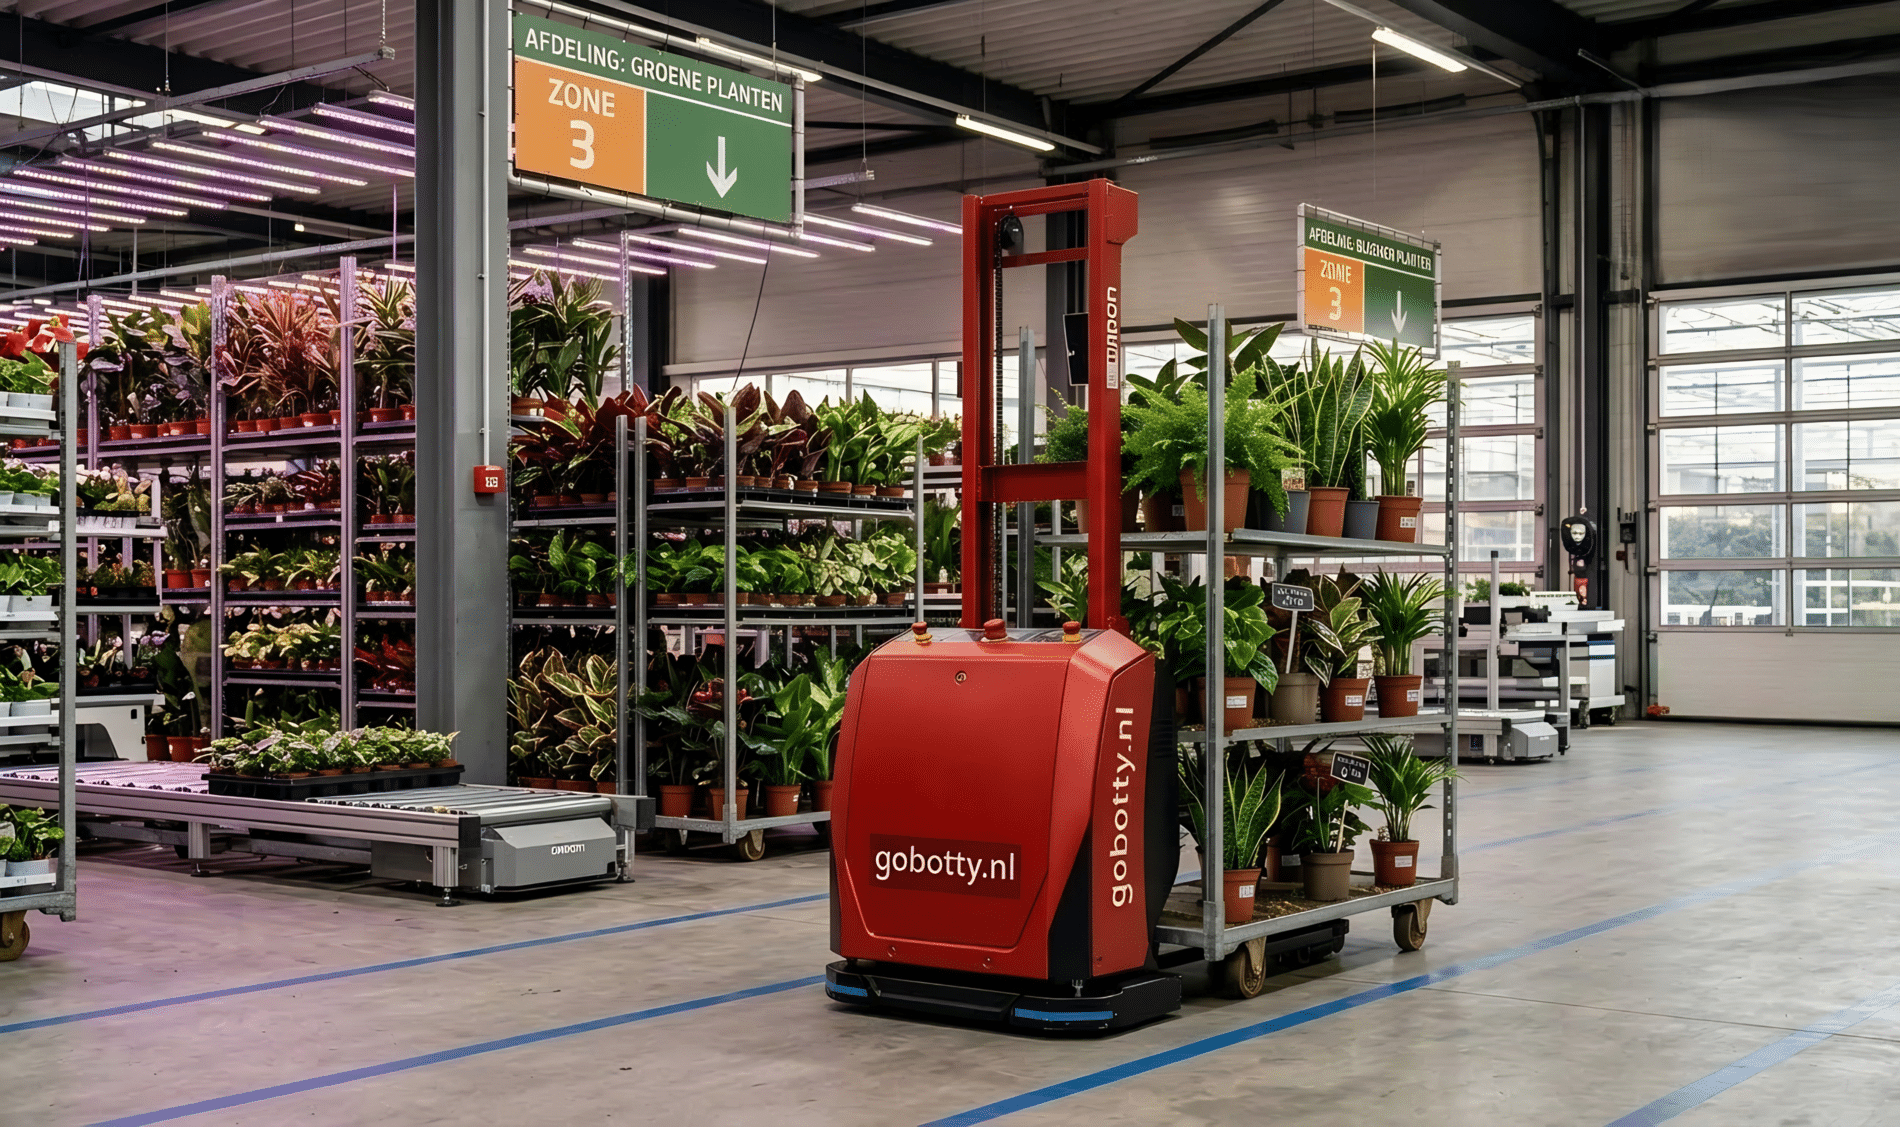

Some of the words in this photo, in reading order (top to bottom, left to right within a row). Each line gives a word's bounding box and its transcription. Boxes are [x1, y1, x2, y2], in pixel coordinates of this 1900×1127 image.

[525, 27, 626, 73] AFDELING:
[631, 56, 702, 92] GROENE
[707, 75, 783, 114] PLANTEN
[548, 78, 616, 118] ZONE
[569, 119, 595, 170] 3
[1329, 286, 1342, 321] 3
[1109, 707, 1137, 908] gobotty.nl
[875, 845, 1015, 887] gobotty.nl
